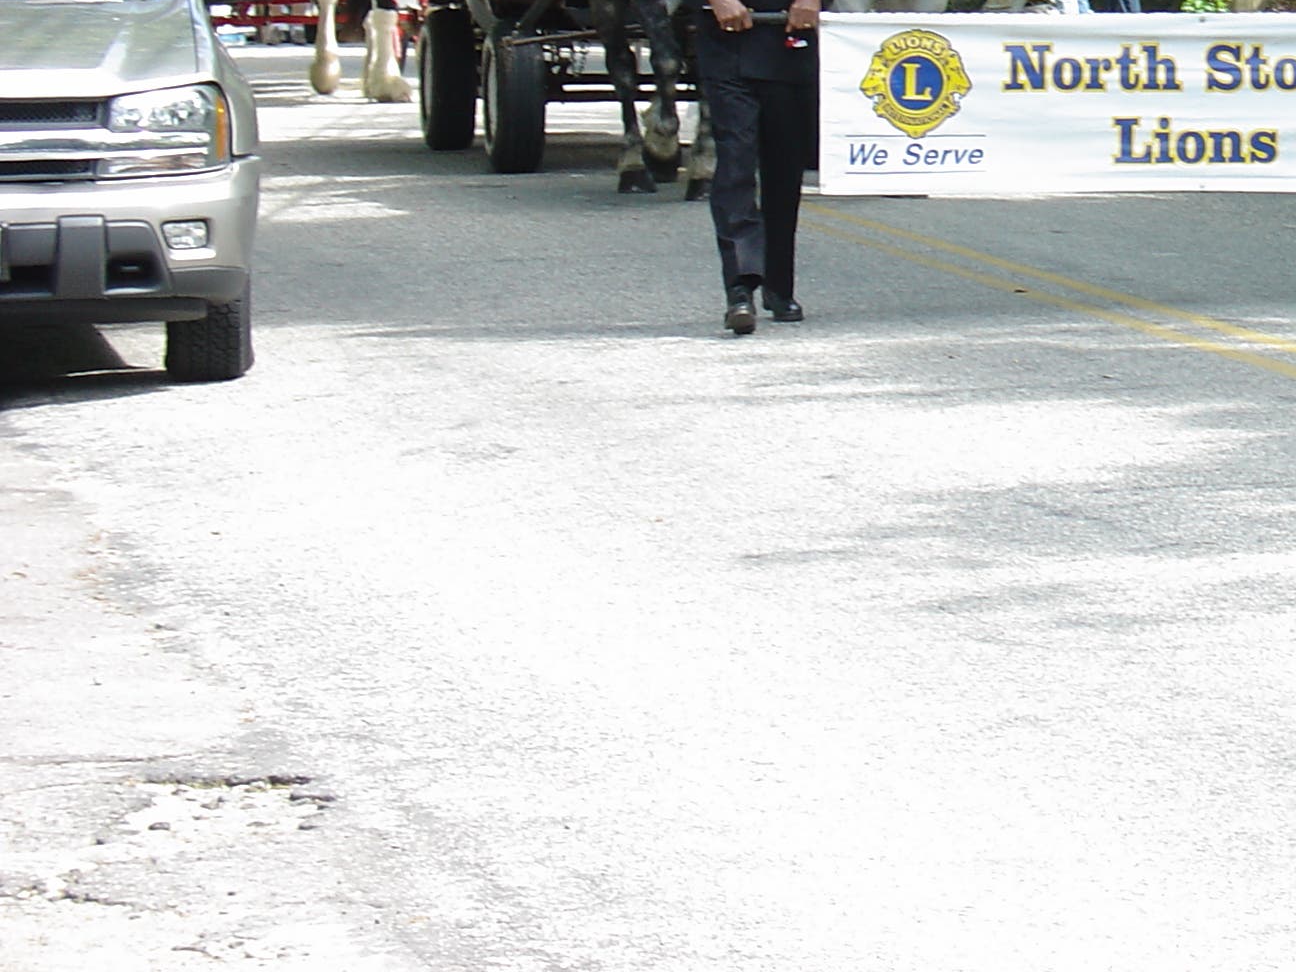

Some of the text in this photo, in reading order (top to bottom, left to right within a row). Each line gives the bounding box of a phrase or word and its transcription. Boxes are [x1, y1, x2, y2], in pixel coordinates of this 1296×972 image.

[890, 36, 945, 56] LIONS
[902, 63, 933, 101] L
[1003, 42, 1182, 92] North
[849, 143, 984, 166] We Serve
[1111, 116, 1280, 166] Lions
